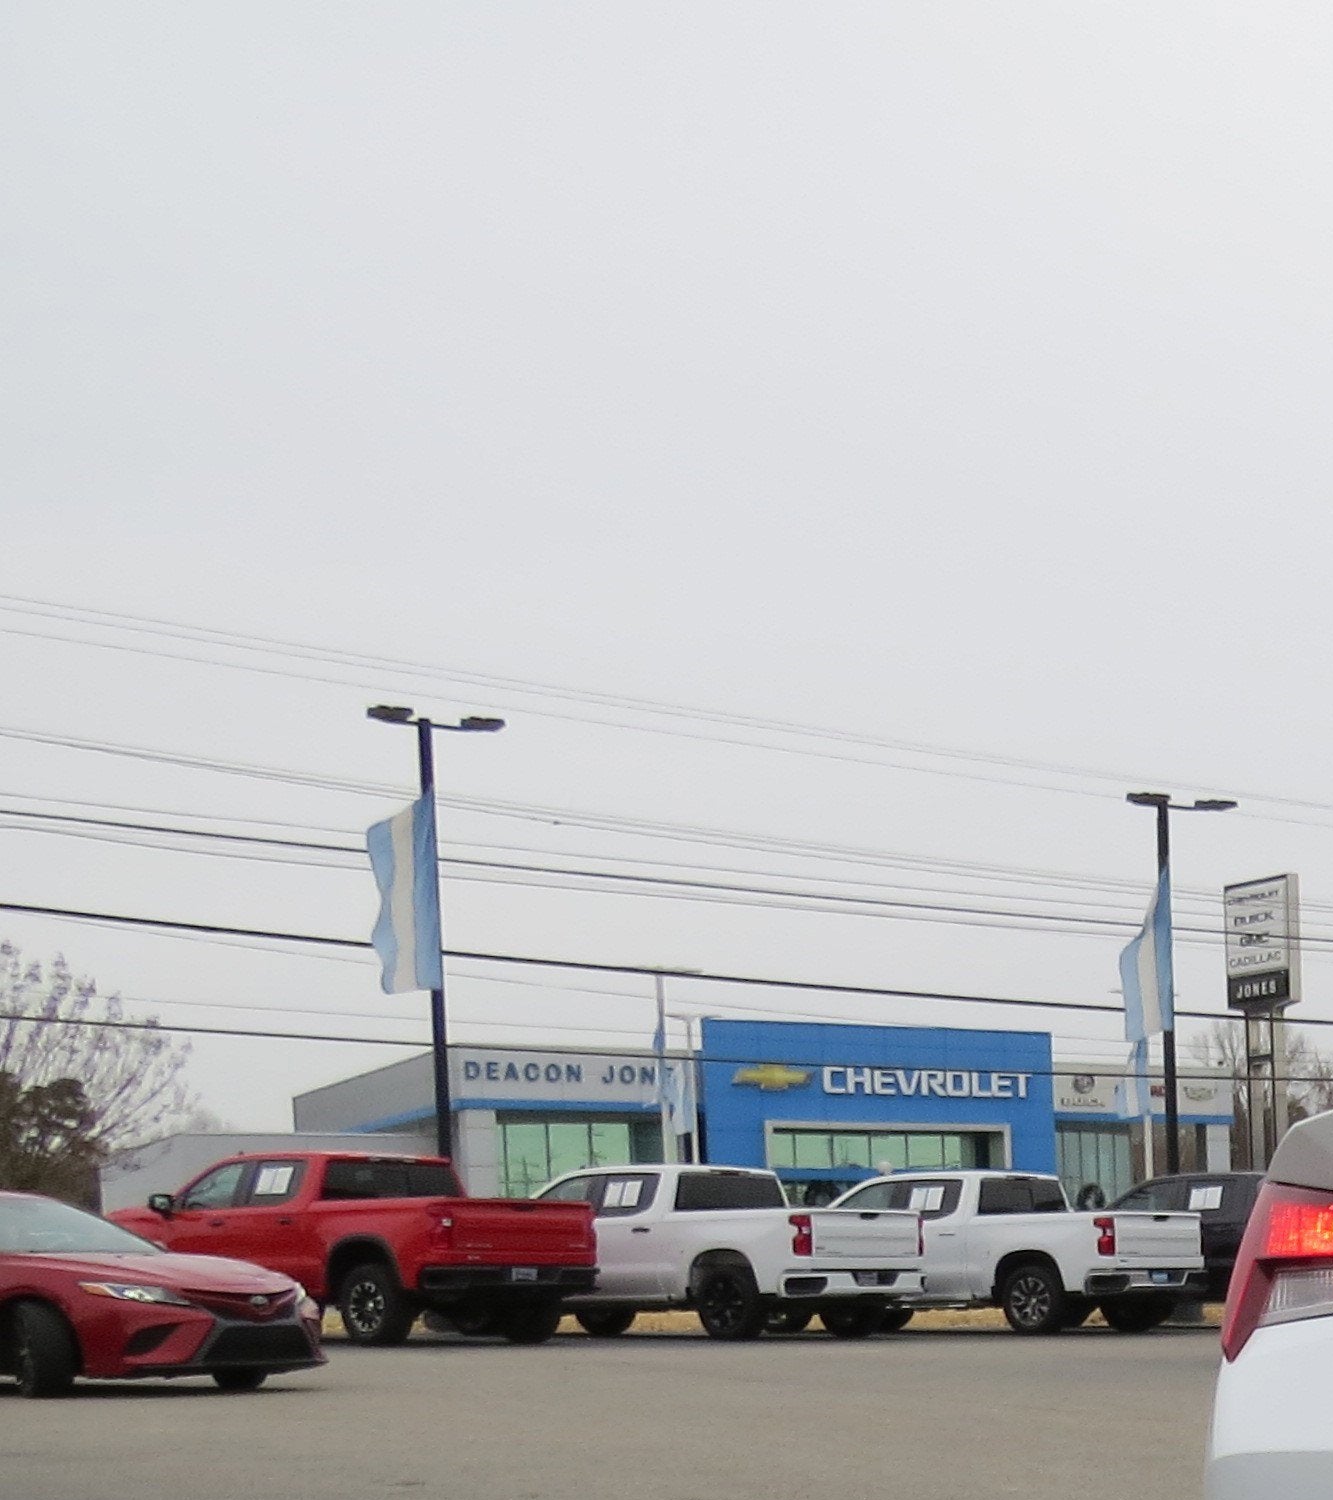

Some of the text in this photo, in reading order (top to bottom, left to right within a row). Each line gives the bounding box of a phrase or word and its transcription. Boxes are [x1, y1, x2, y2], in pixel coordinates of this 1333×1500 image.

[1236, 978, 1277, 999] JONES
[463, 1061, 674, 1085] DEACON JON
[822, 1066, 1032, 1098] CHEVROLET
